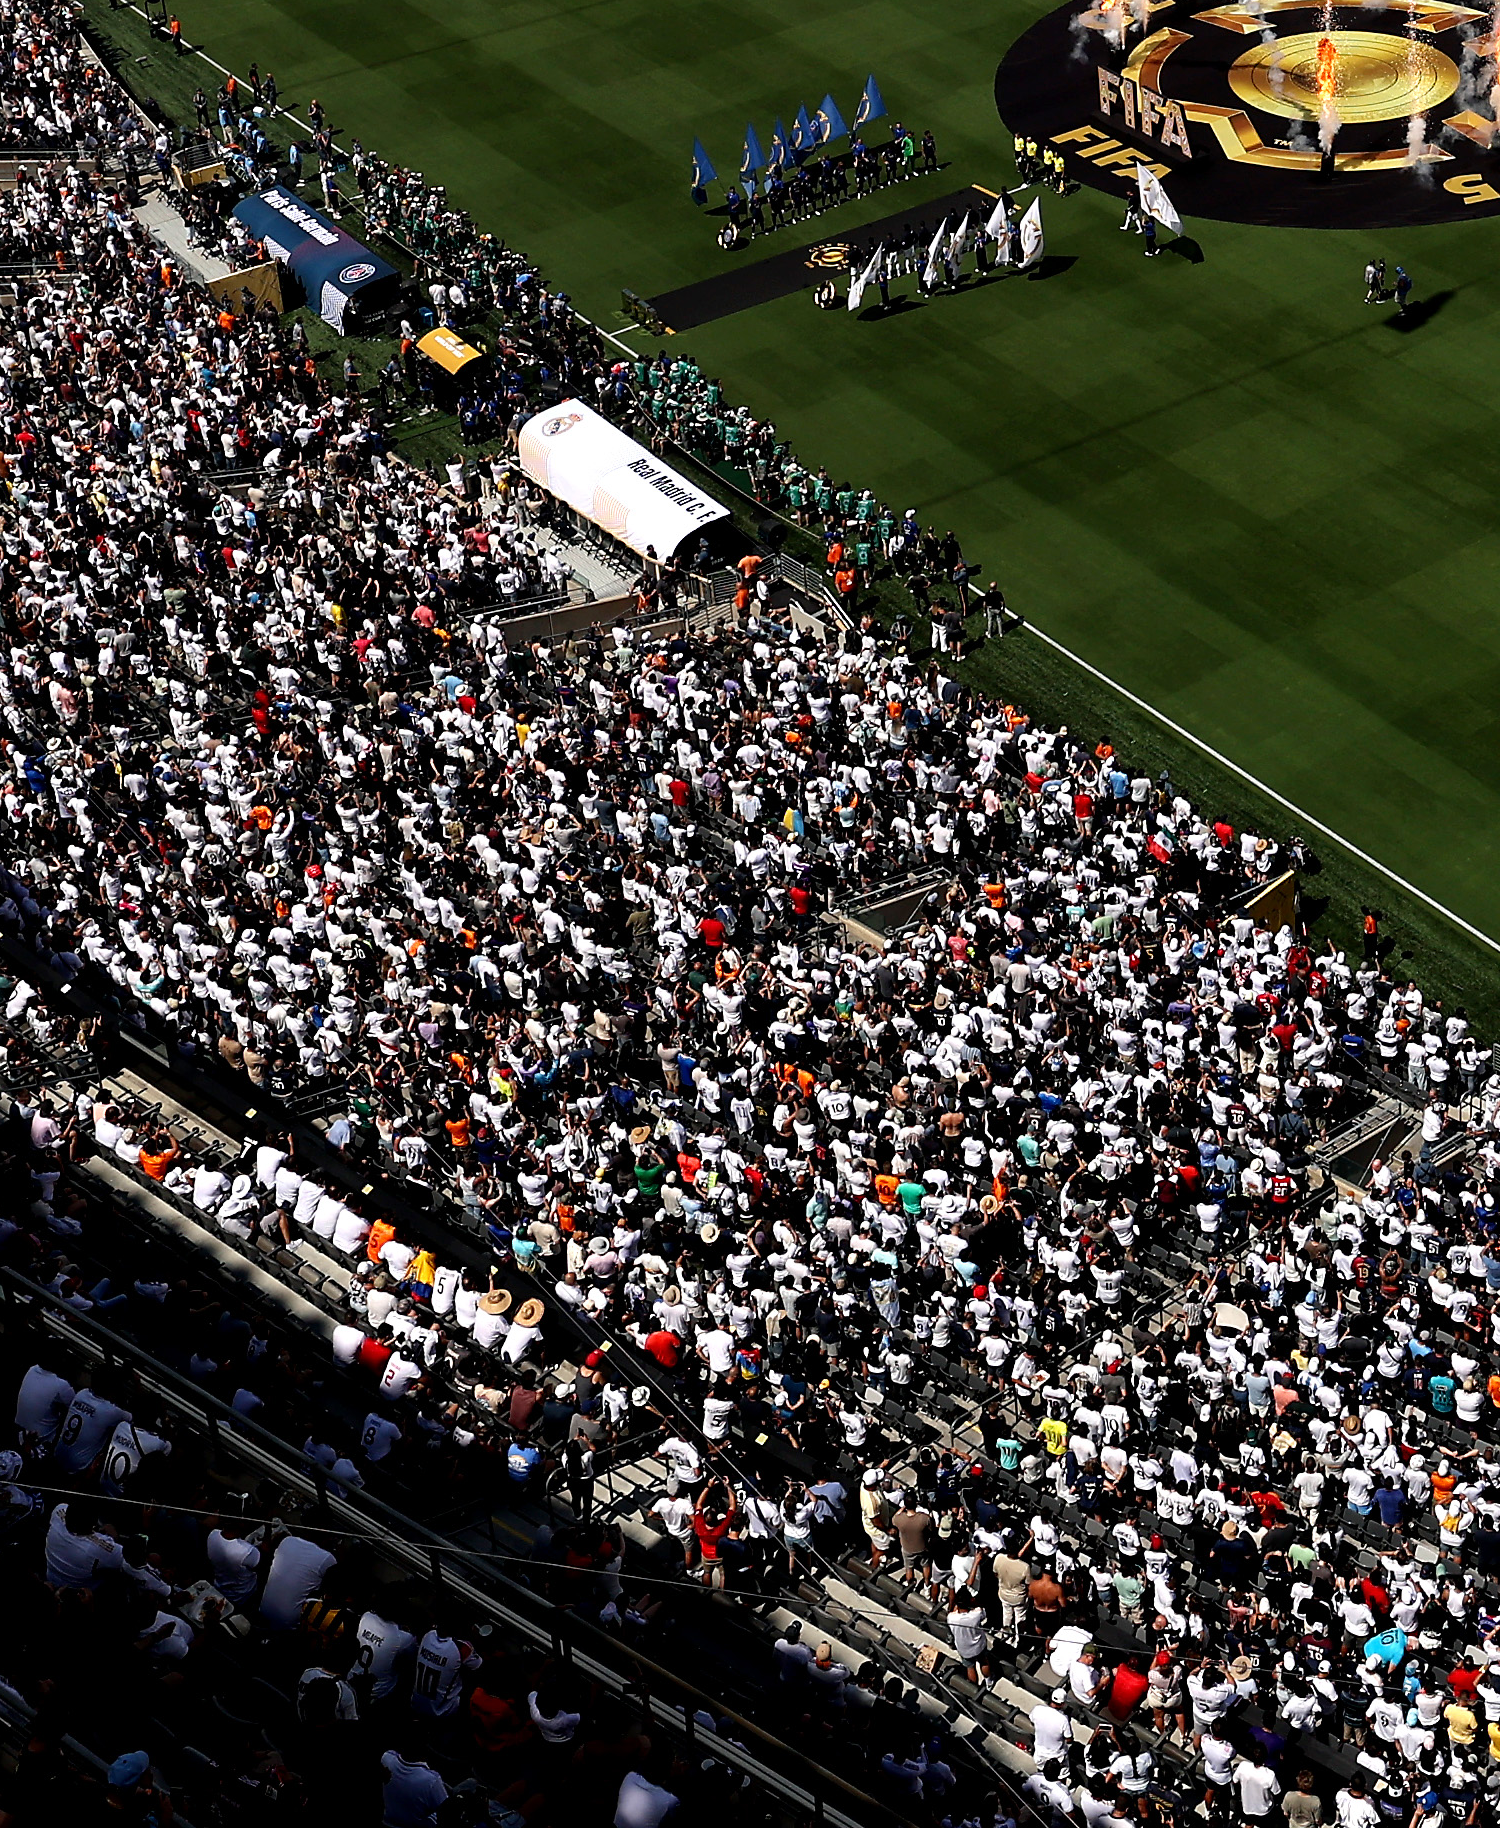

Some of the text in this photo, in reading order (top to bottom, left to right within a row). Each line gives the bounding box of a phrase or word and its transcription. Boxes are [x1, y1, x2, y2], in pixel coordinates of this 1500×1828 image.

[1097, 64, 1195, 160] FIFA
[1050, 123, 1175, 180] FIFA
[259, 188, 290, 214] Paris
[627, 458, 717, 523] Real Madrid C. F.
